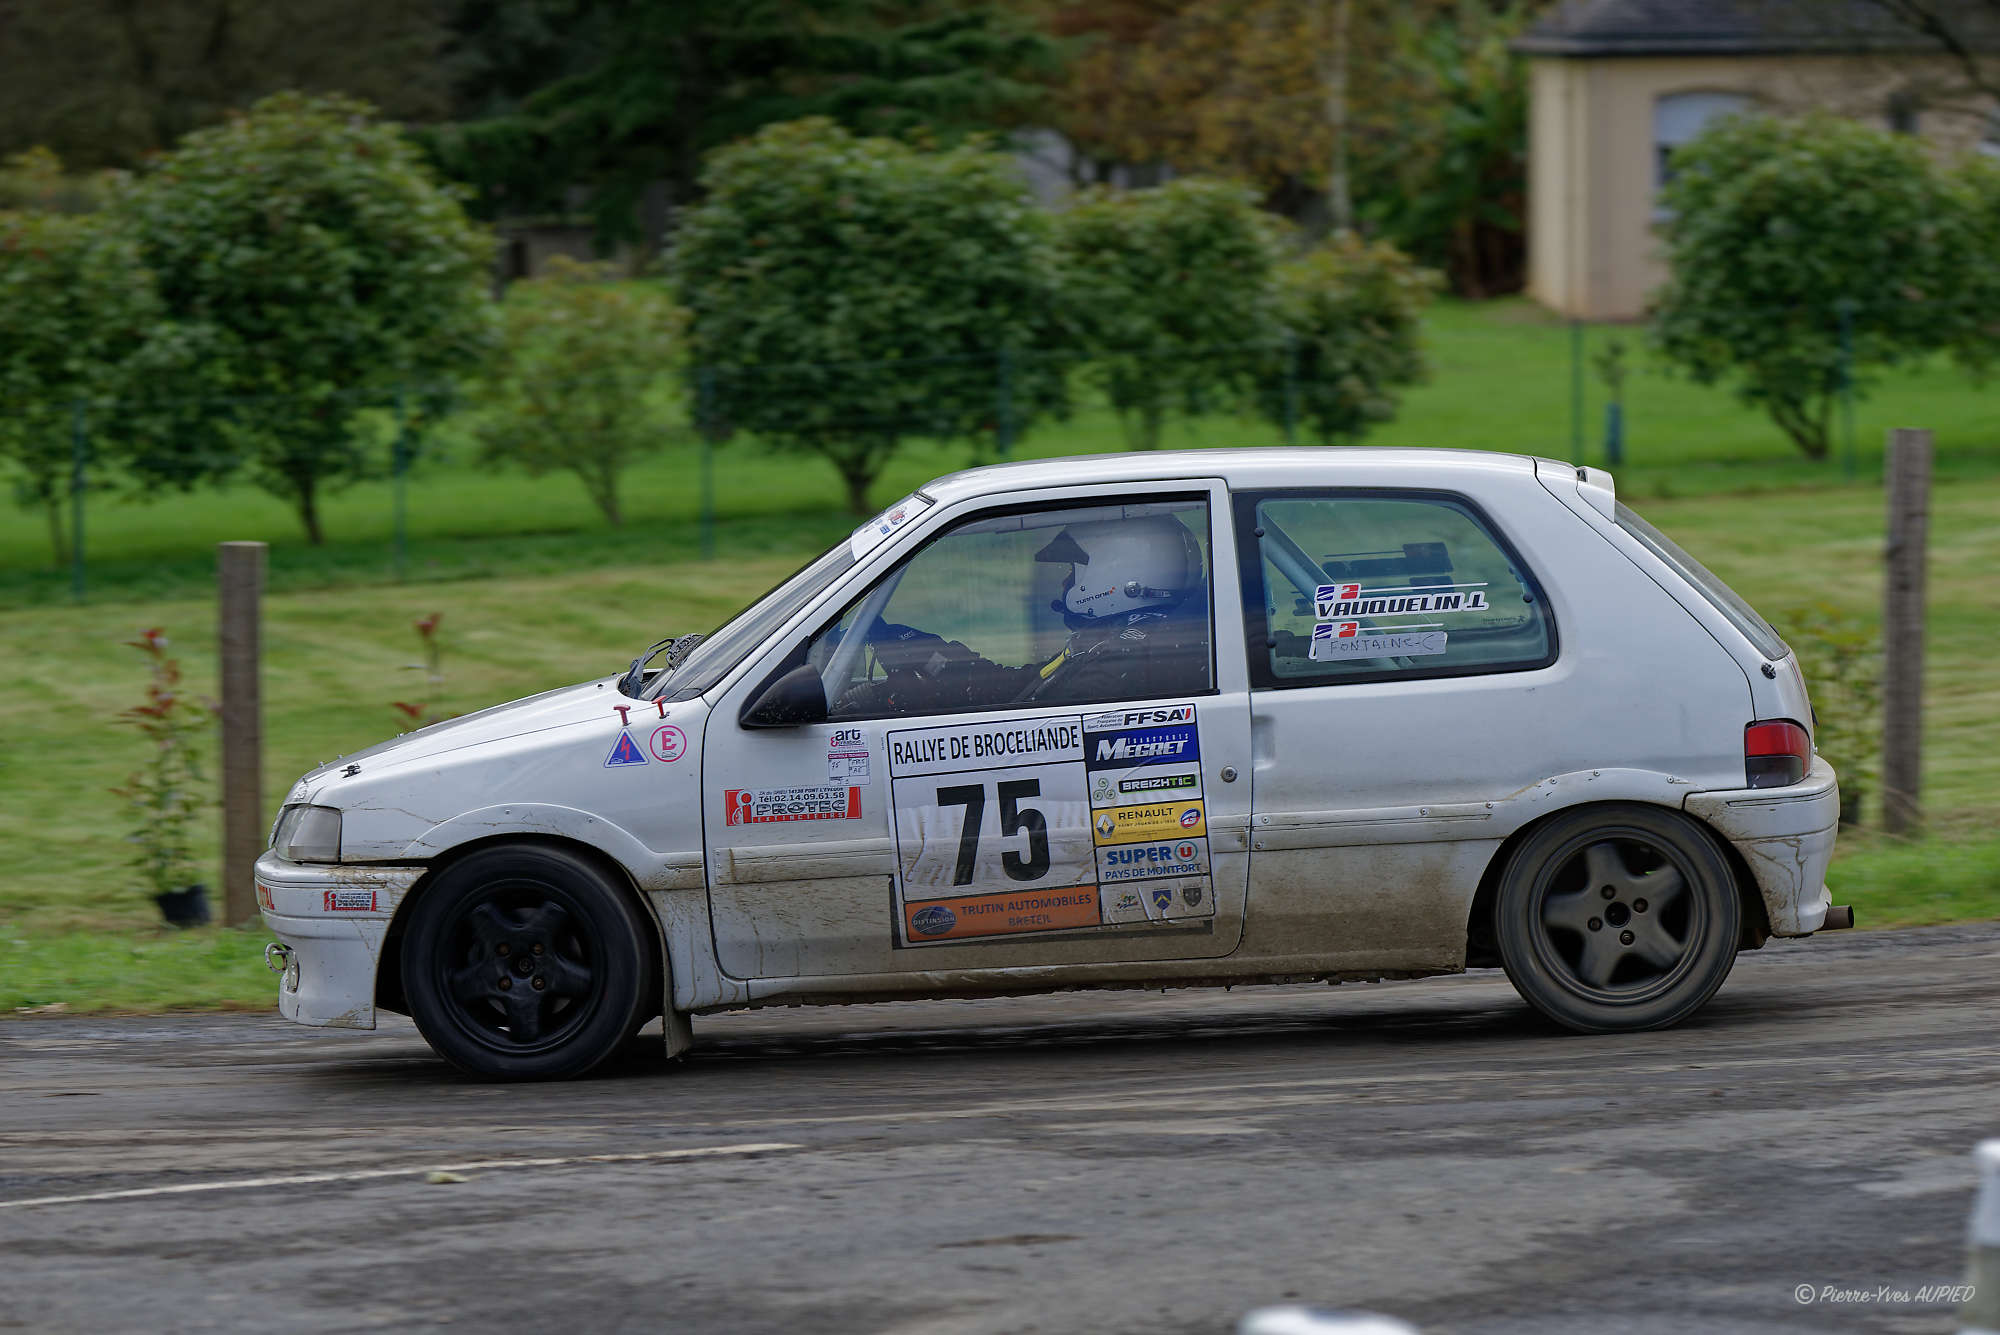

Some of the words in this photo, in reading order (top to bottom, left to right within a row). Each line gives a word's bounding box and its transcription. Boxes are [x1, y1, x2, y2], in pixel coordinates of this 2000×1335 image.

[1318, 595, 1460, 617] VAUQUELIN
[1124, 709, 1184, 725] FFSA
[893, 738, 946, 764] RALLYE
[951, 736, 970, 759] DE
[974, 726, 1079, 757] BROCELIANDE
[1118, 808, 1174, 820] RENAULT
[936, 778, 1050, 887] 75
[1106, 846, 1172, 866] SUPER
[1105, 869, 1130, 879] PAYS
[1132, 868, 1145, 877] DE
[1147, 863, 1200, 876] MONTFORT
[960, 903, 1004, 916] TRUTIN
[1007, 894, 1091, 911] AUTOMOBILES
[1008, 914, 1052, 927] BRETEIL
